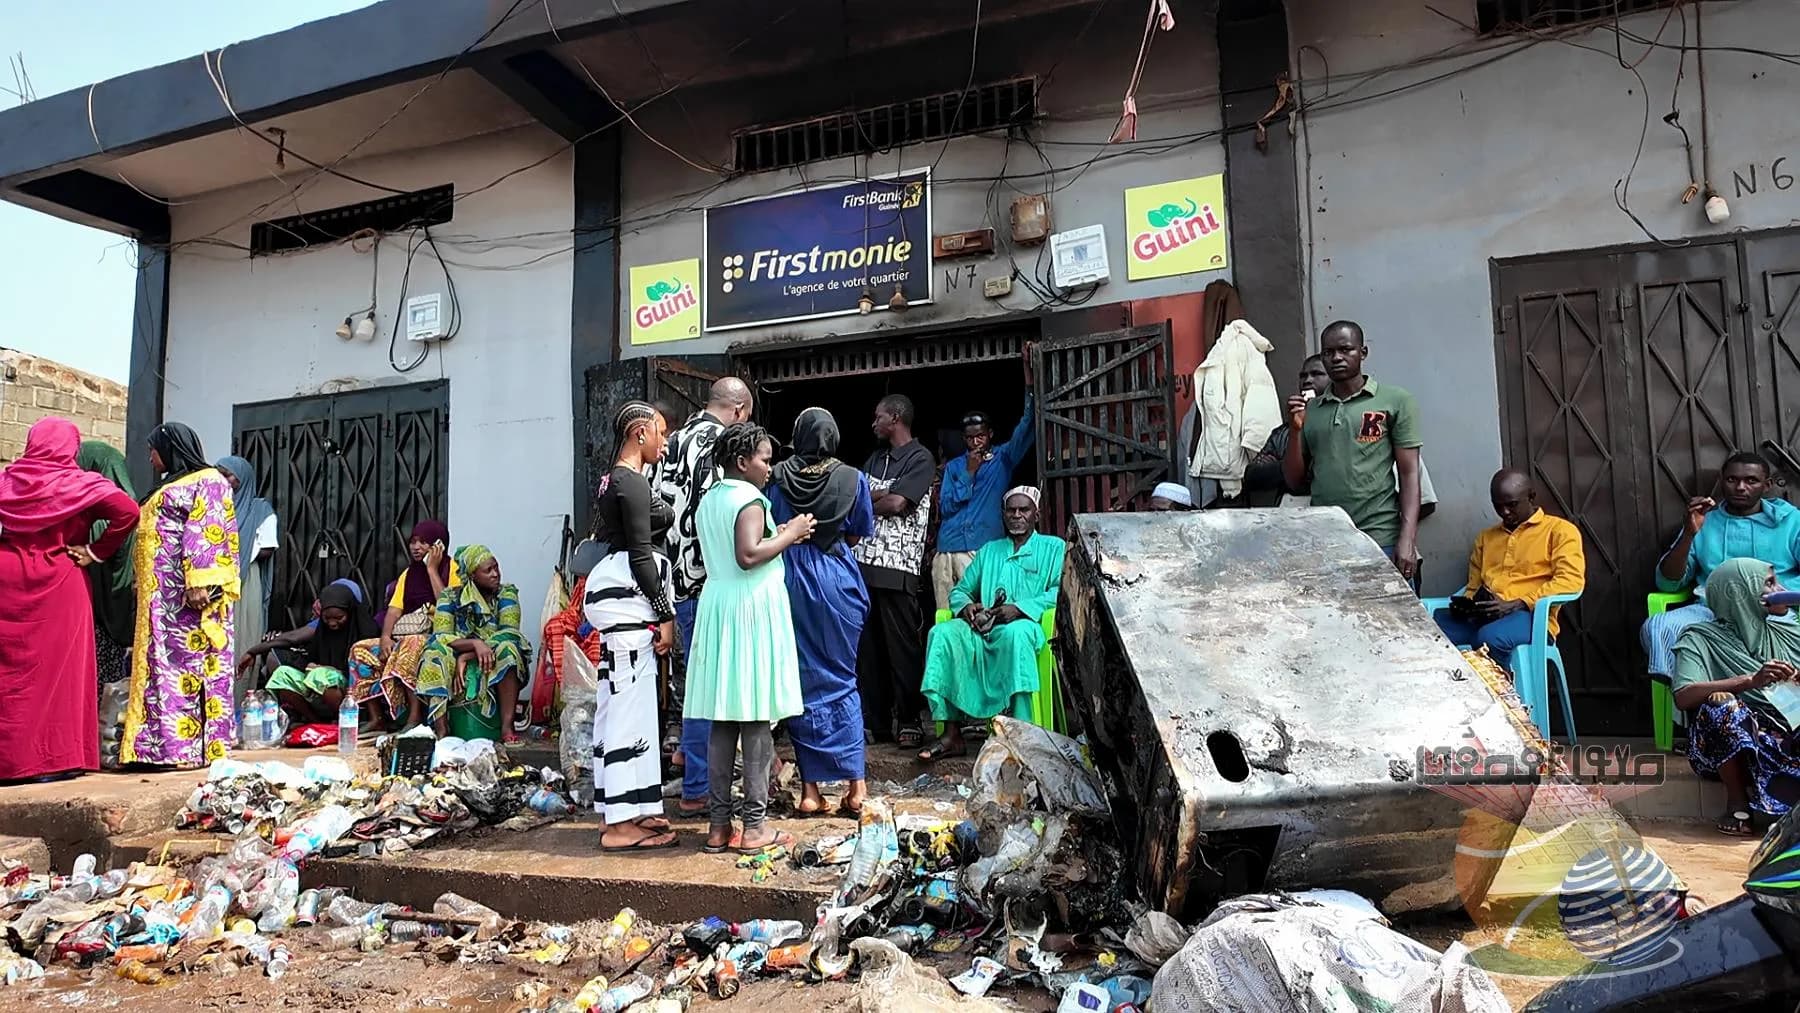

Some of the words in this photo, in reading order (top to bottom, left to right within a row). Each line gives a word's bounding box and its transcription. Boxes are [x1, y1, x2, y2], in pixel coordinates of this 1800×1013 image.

[842, 190, 904, 209] FirstBank
[1134, 205, 1220, 261] Guini
[749, 236, 912, 282] Firstmonie
[783, 281, 825, 296] L'agence
[827, 280, 840, 290] de
[842, 277, 868, 288] votre
[870, 271, 910, 287] quartier
[635, 284, 697, 329] Guini
[1360, 410, 1386, 437] K
